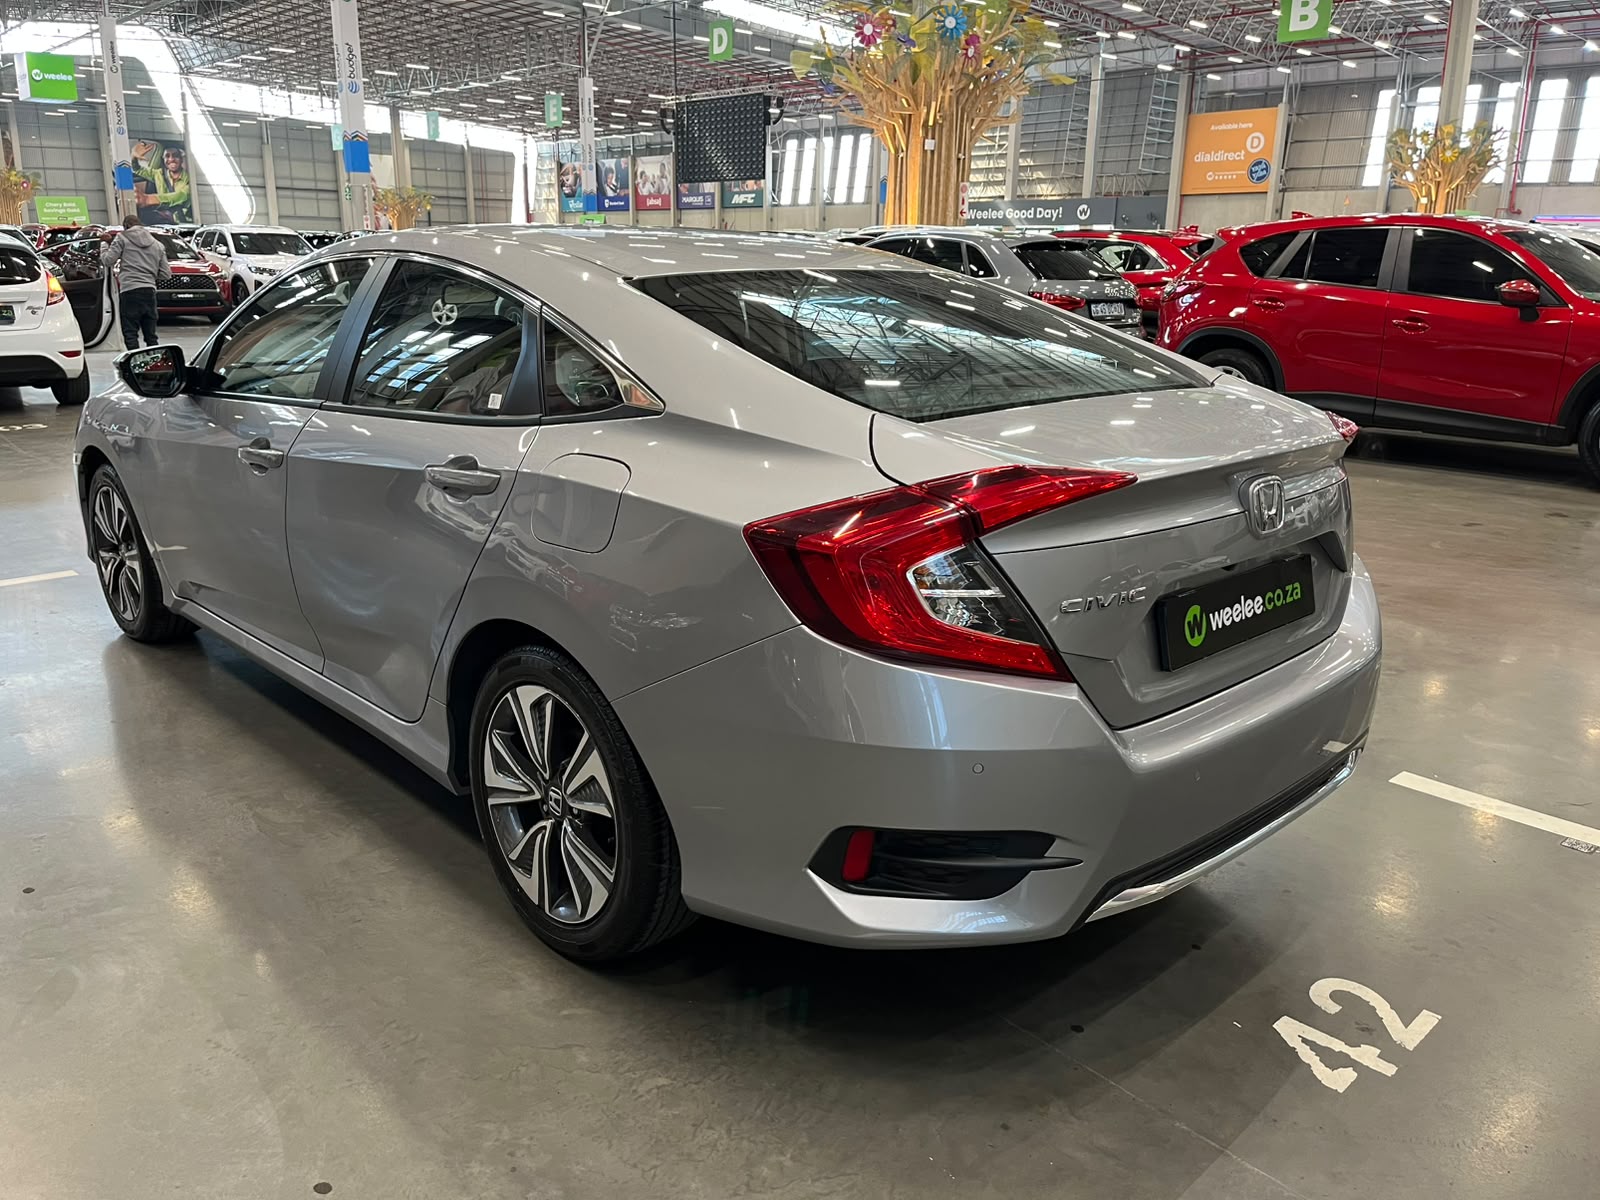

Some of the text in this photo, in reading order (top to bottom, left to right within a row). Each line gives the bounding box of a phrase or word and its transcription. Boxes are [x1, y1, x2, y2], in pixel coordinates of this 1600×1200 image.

[1289, 0, 1319, 31] B
[713, 28, 728, 54] D
[345, 43, 358, 80] budget
[44, 73, 73, 81] weelee
[550, 98, 559, 121] E
[1194, 150, 1245, 162] dialdirect
[731, 193, 755, 204] MFC
[967, 209, 1004, 219] Weelee
[1005, 208, 1034, 219] Good
[1036, 207, 1063, 221] Day!
[1059, 586, 1147, 614] CIVIC
[1209, 582, 1301, 631] weelee.co.za
[1272, 977, 1443, 1093] 42
